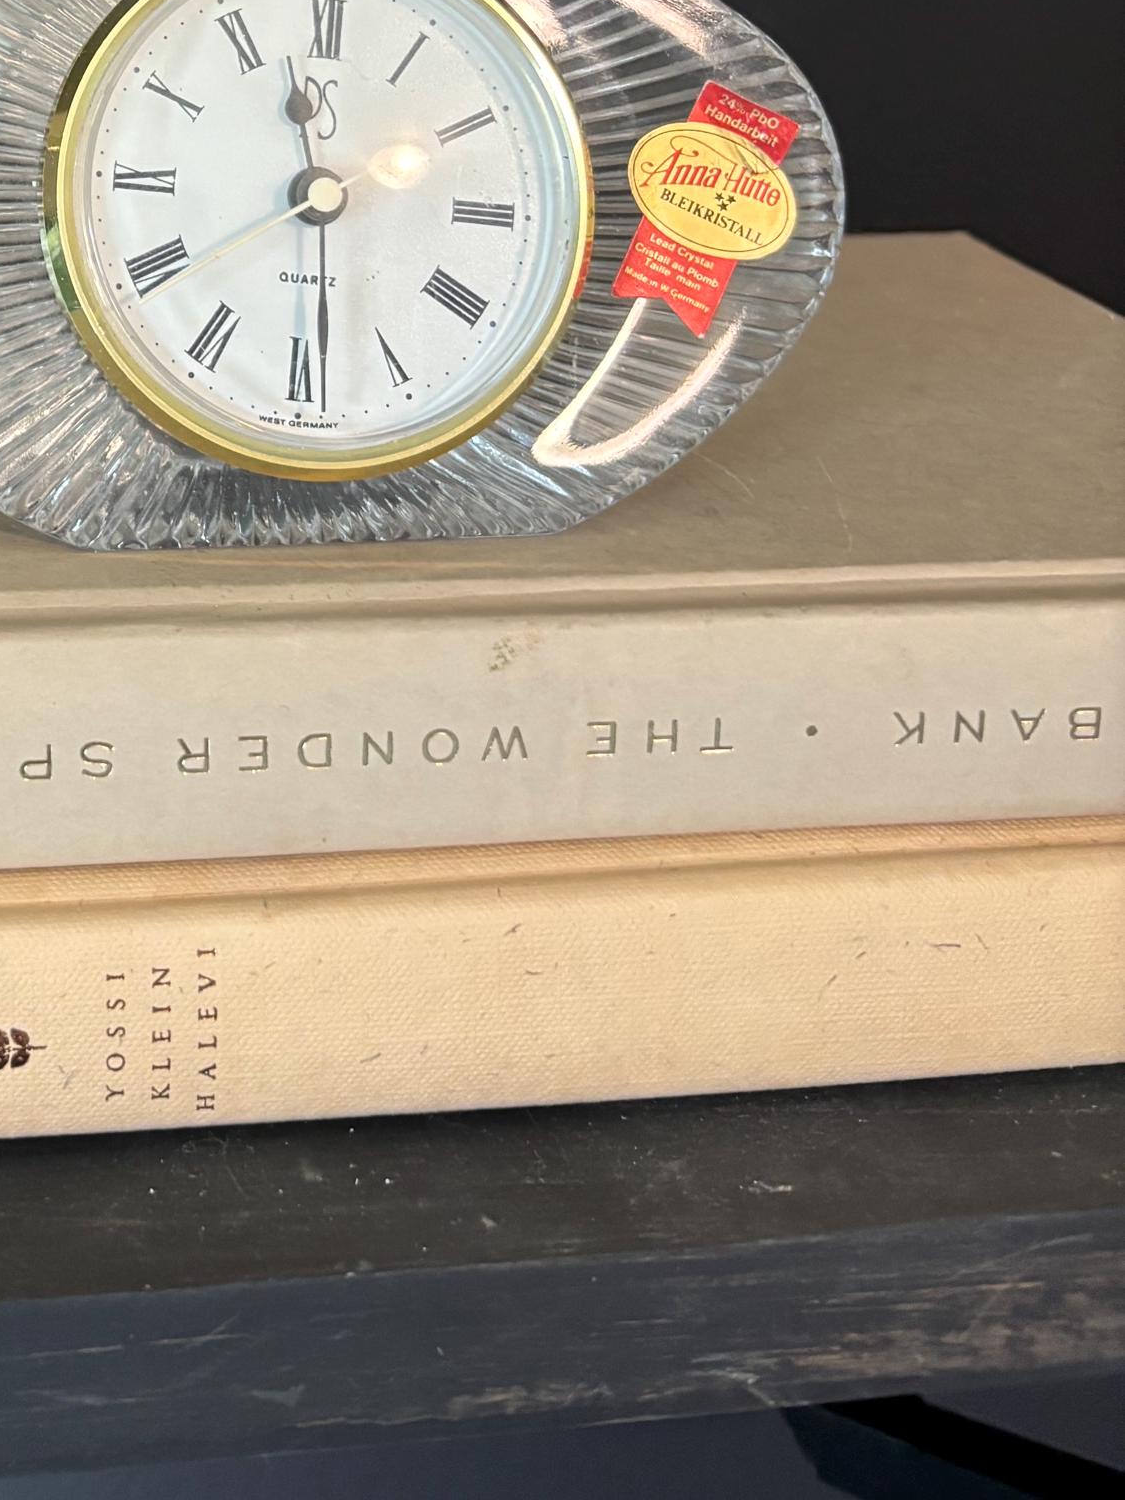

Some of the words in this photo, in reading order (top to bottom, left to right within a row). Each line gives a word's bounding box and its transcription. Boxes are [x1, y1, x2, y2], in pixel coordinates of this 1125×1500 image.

[214, 8, 267, 75] XI
[142, 70, 205, 123] X
[434, 105, 498, 148] II
[704, 104, 779, 148] Handarbeit
[749, 108, 780, 130] PbO
[112, 160, 177, 197] IX
[639, 147, 722, 188] Anna
[451, 197, 515, 232] III
[660, 187, 764, 246] BLEIKRISTALL
[124, 234, 191, 299] VIII
[650, 233, 676, 252] Lead
[677, 247, 714, 270] Crystal
[279, 271, 337, 287] QUARZ
[625, 265, 648, 283] Made
[670, 288, 710, 313] Germany
[644, 257, 671, 276] Taille
[676, 275, 701, 291] main
[671, 261, 685, 272] au
[687, 267, 719, 288] Plomb
[184, 300, 241, 373] VII
[375, 325, 414, 388] V
[284, 336, 315, 403] VI
[259, 414, 286, 426] WEST
[288, 419, 339, 429] GERMANY
[585, 717, 735, 757] THE
[893, 705, 1103, 748] BANK
[177, 726, 529, 777] WONDER
[106, 973, 125, 1101] YOSSI
[152, 967, 171, 1100] KLEIN
[196, 948, 218, 1111] HALEVI
